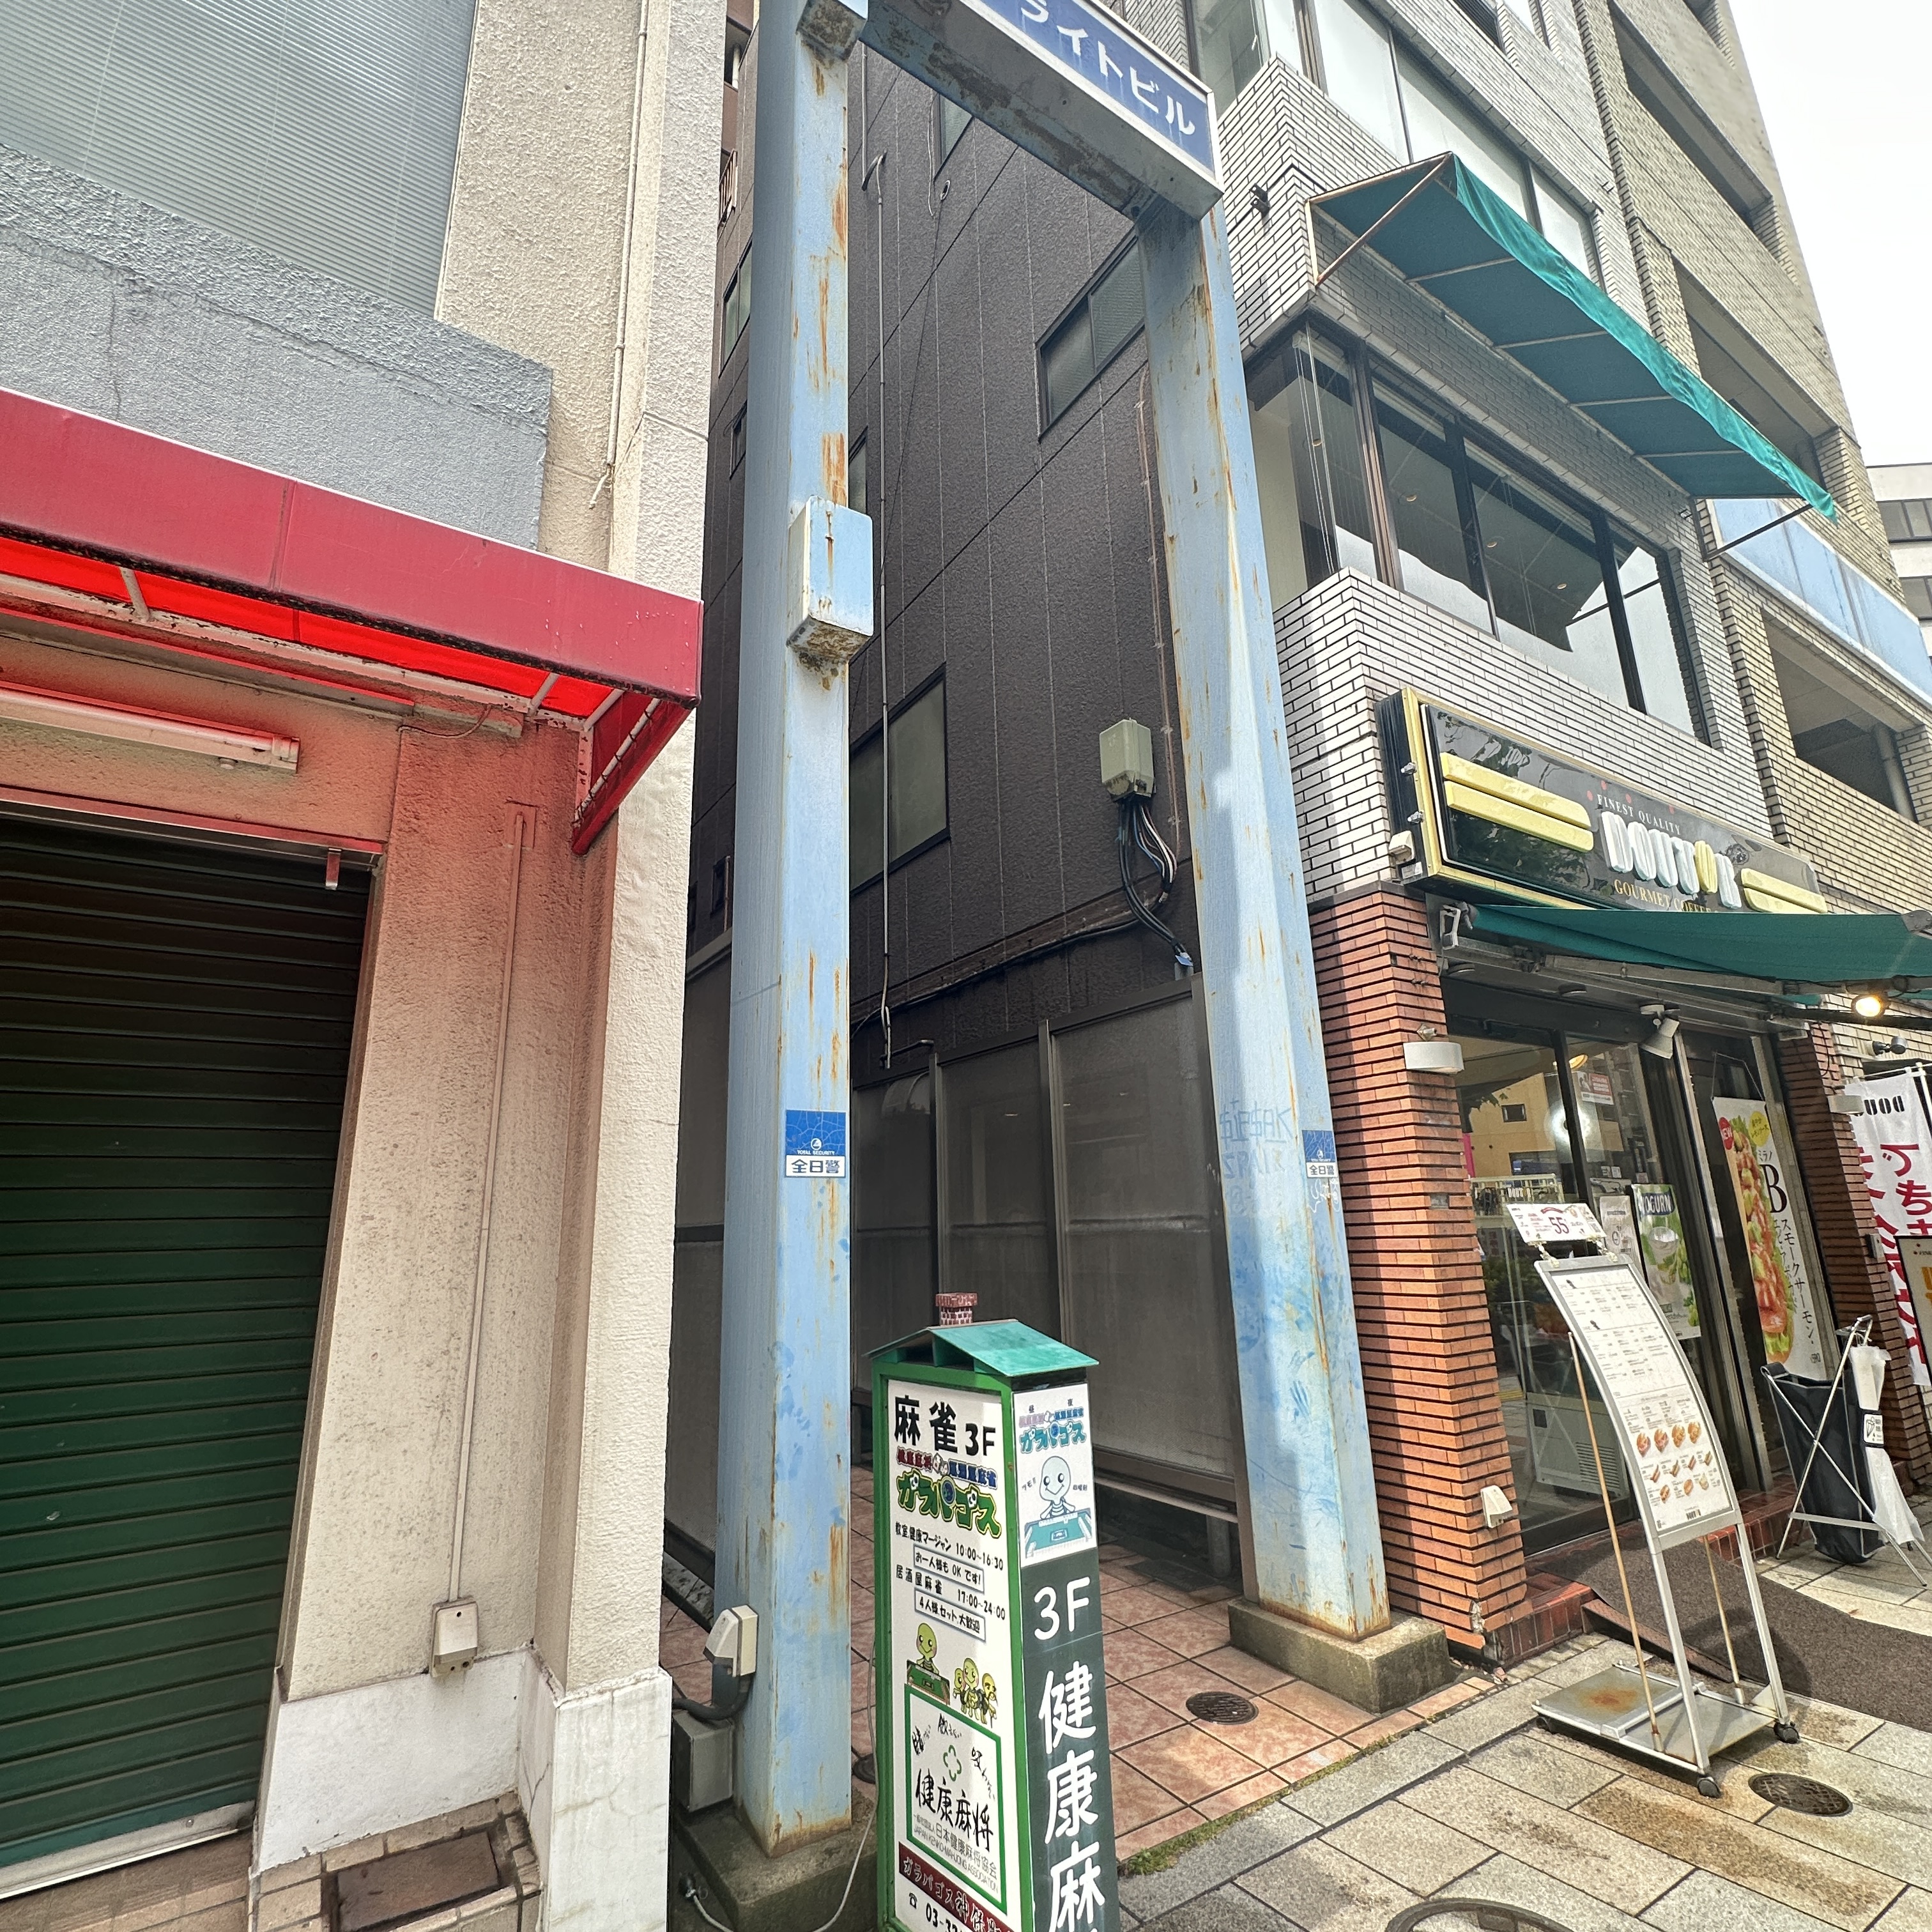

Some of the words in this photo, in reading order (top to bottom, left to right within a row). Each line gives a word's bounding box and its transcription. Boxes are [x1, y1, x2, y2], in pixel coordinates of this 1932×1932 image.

[1597, 794, 1634, 817] FINEST
[1639, 810, 1681, 835] QUALITY
[1614, 879, 1670, 908] GOURMET
[791, 1159, 840, 1174] 全日警
[1759, 1164, 1788, 1213] B
[896, 1468, 1002, 1538] ガラパゴス
[1034, 1576, 1091, 1641] 3F
[915, 1768, 994, 1852] 健康麻将
[1038, 1660, 1106, 1932] 健康麻
[903, 1856, 1013, 1932] ガラパゴス神保
